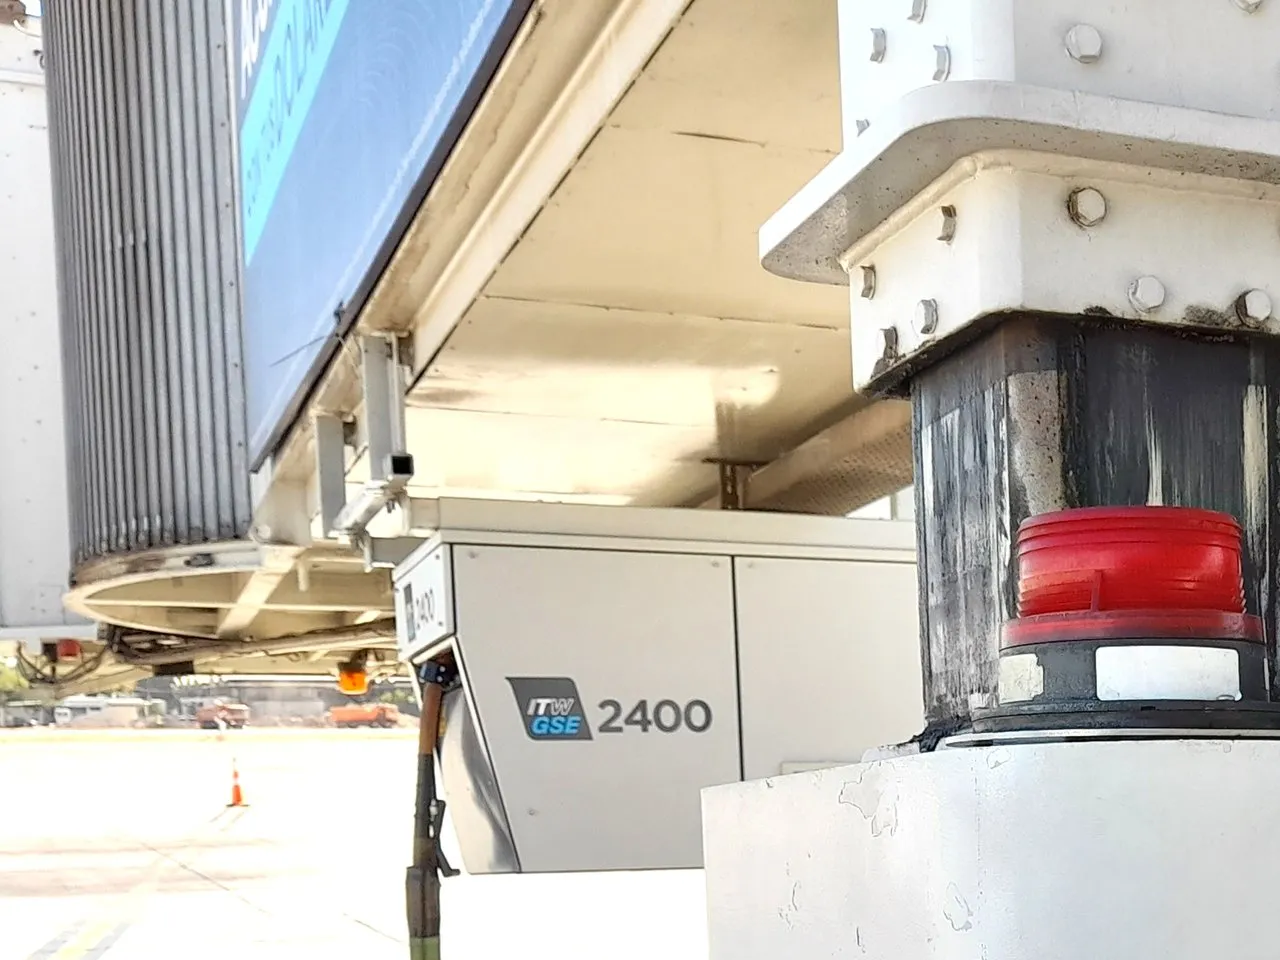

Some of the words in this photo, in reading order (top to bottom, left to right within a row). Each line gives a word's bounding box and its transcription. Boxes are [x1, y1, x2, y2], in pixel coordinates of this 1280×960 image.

[527, 698, 574, 716] ITW
[598, 699, 713, 733] 2400
[532, 715, 581, 735] GSE
